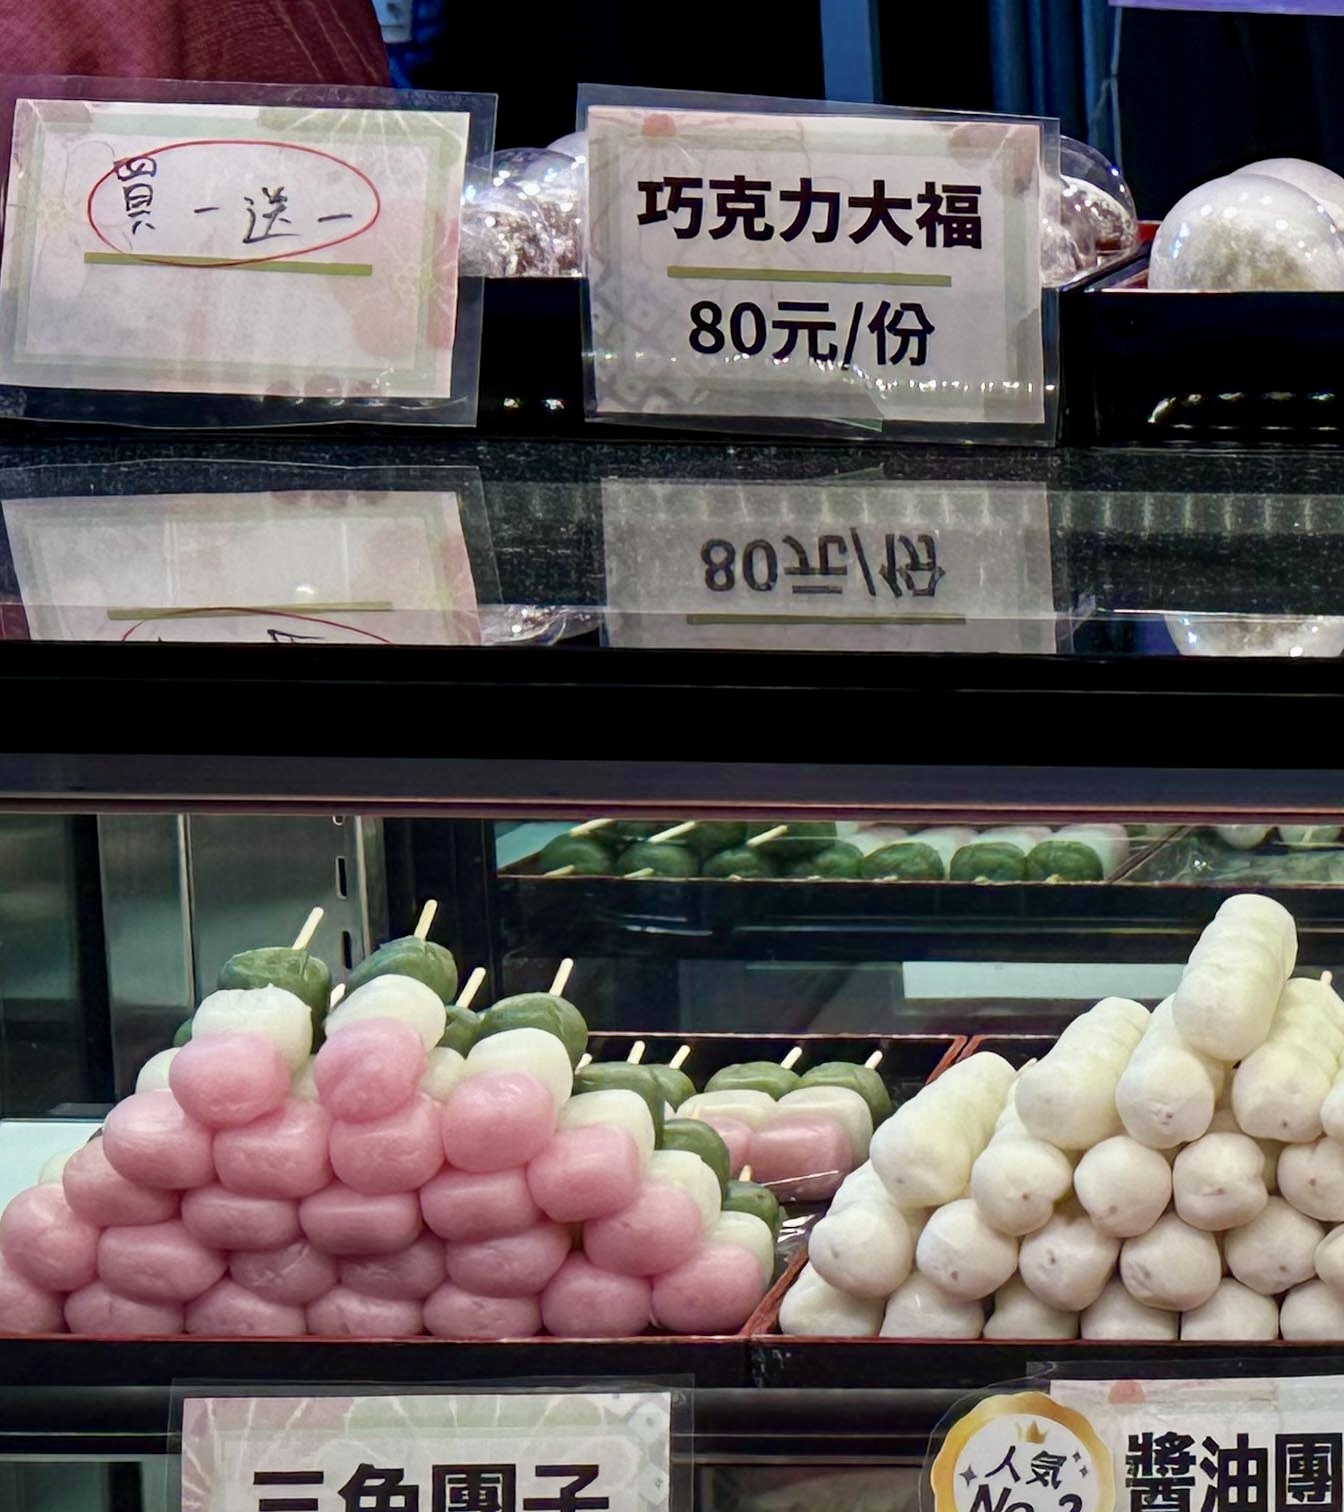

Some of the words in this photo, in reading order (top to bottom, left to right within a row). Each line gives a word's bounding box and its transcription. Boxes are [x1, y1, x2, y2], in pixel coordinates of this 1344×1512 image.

[113, 157, 352, 243] 買一送一
[637, 175, 982, 249] 巧克力大福
[689, 300, 935, 369] 80元/份
